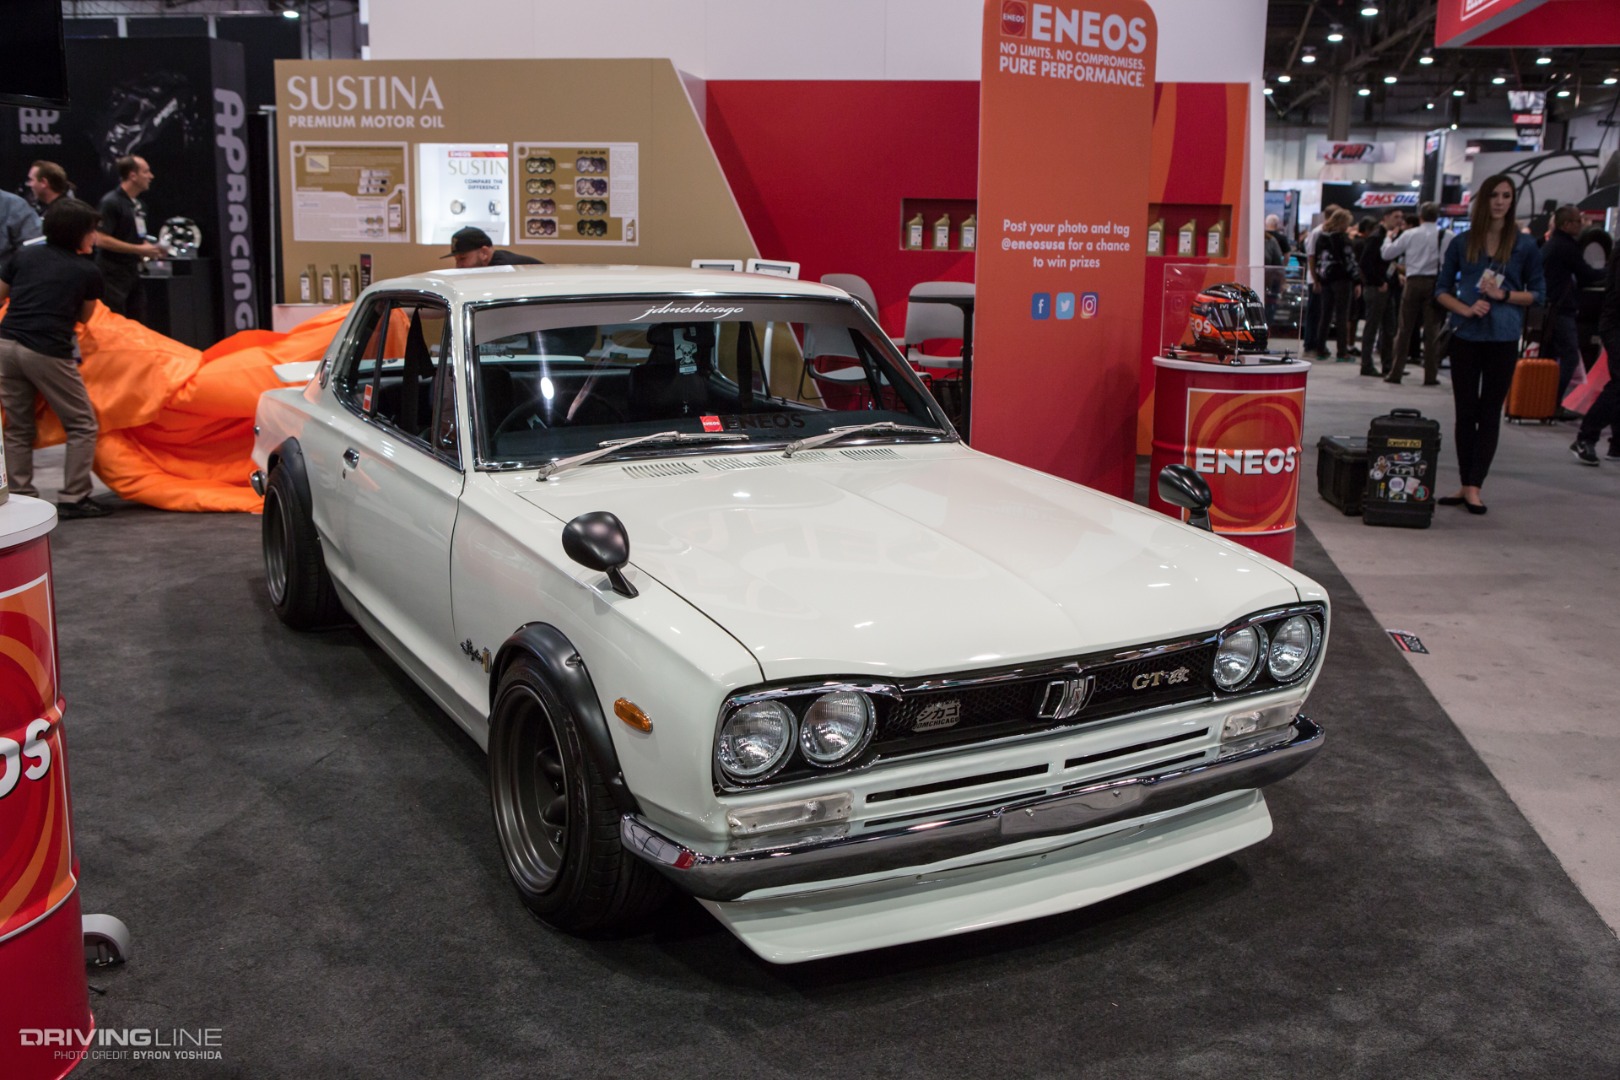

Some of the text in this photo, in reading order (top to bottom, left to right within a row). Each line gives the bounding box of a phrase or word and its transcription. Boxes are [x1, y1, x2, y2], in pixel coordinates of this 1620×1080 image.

[1003, 13, 1025, 24] ENEOS
[1032, 3, 1147, 54] ENEOS
[1000, 42, 1146, 71] NO LIMITS. NO COMPROMISES.
[1000, 56, 1145, 88] PURE PERFORMANCE.
[287, 75, 445, 111] SUSTINA
[18, 107, 60, 133] AP
[288, 115, 445, 128] PREMIUM MOTOR OIL
[20, 133, 62, 145] RACING
[1361, 194, 1416, 206] AMSOIL
[1003, 219, 1130, 238] Post your photo and tag
[1001, 237, 1130, 251] @eneosusa for a chance
[1033, 255, 1100, 271] to win prizes
[629, 301, 744, 321] jdmchicago
[1195, 446, 1296, 475] ENEOS
[918, 704, 959, 721] シカゴ
